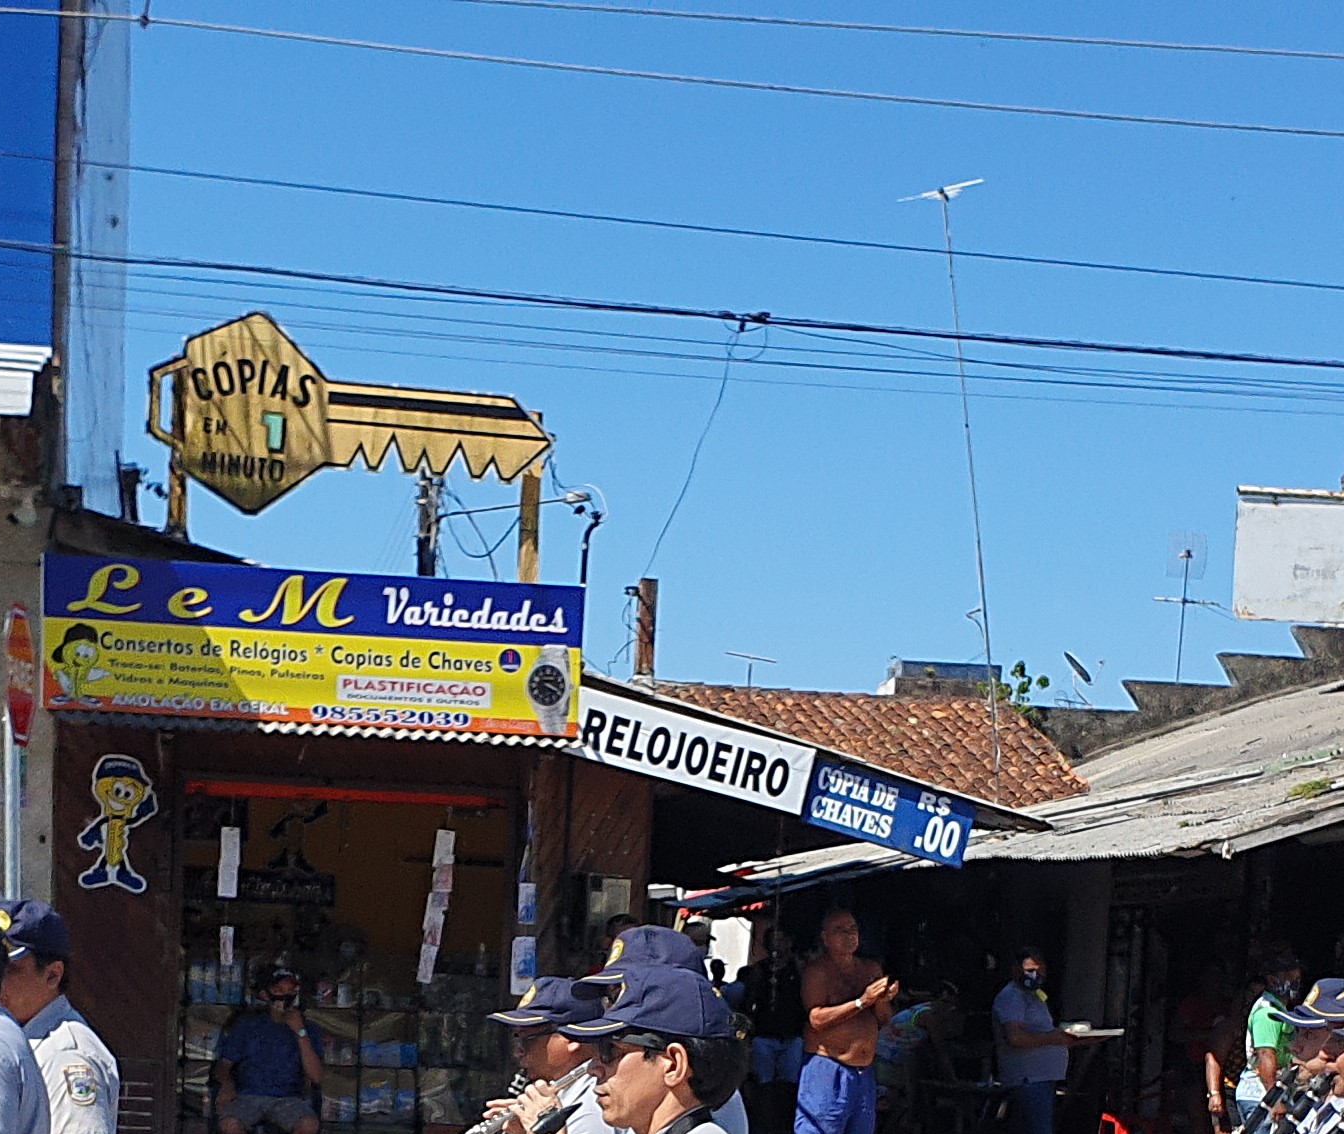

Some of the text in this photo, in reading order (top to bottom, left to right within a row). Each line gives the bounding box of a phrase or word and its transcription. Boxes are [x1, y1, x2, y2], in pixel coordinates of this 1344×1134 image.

[191, 351, 317, 408] CÓPIAS
[202, 416, 229, 436] EM
[262, 410, 287, 454] 1
[200, 452, 285, 482] MINUTO
[66, 563, 569, 634] L e M Variedades
[100, 631, 308, 667] Consertos de Relógios
[330, 645, 493, 673] Copias de Chaves
[113, 673, 153, 684] Vidros
[269, 668, 326, 681] Pulseiras
[342, 678, 487, 698] PLASTIFICAÇÃO
[111, 691, 290, 716] AMOLAÇÃO EM GERAL
[311, 704, 473, 728] 985552039
[582, 707, 790, 798] RELOJOEIRO
[817, 765, 899, 812] CÓPIA DE
[810, 795, 894, 839] CHAVES
[916, 791, 952, 817] R$
